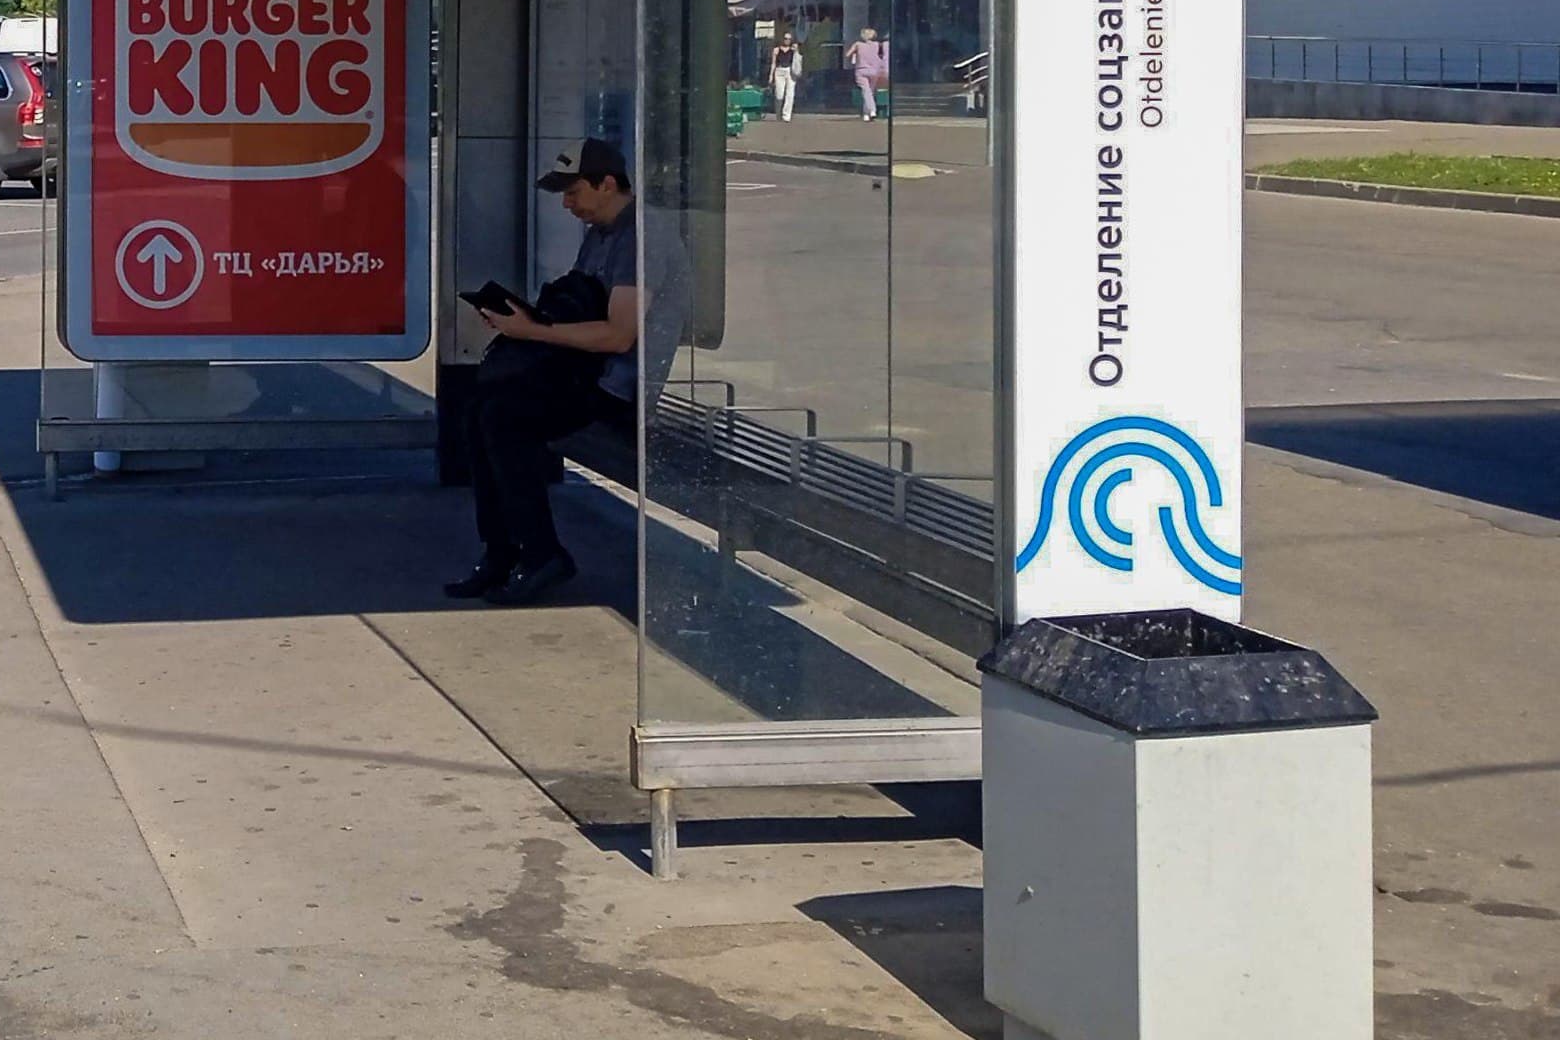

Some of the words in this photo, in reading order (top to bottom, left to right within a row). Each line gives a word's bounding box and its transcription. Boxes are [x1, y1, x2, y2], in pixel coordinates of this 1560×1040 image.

[128, 39, 371, 116] KING
[213, 252, 252, 277] ТЦ
[261, 252, 384, 277] «ДАРЬЯ»
[1089, 145, 1128, 387] Отделение
